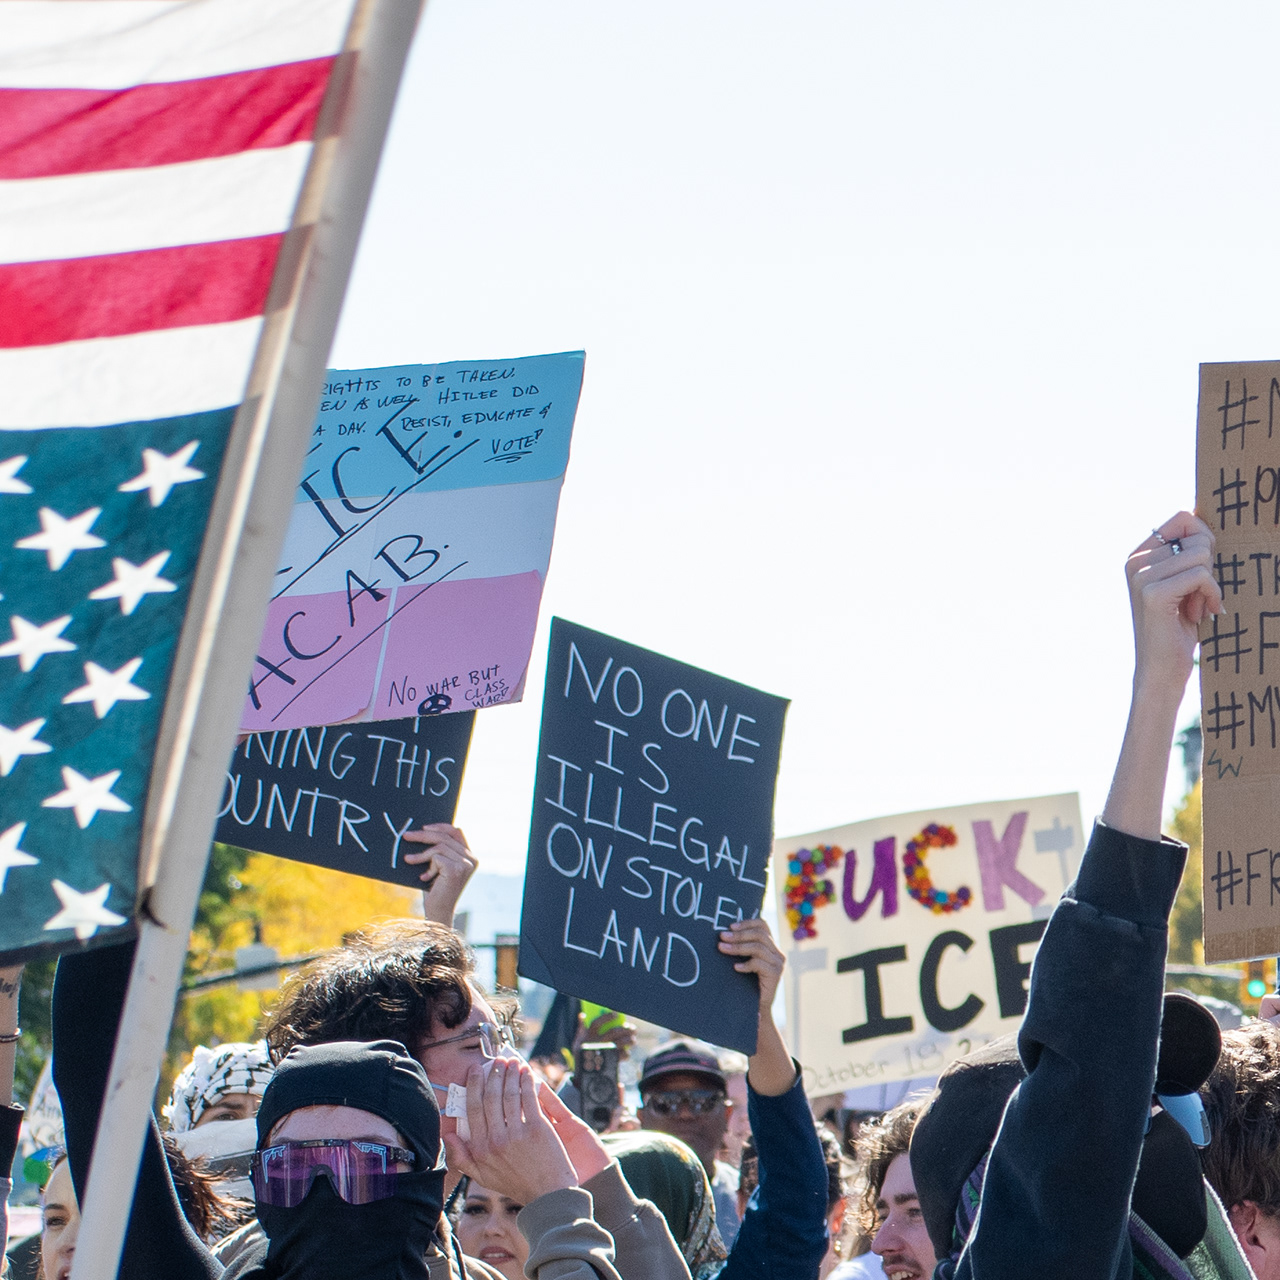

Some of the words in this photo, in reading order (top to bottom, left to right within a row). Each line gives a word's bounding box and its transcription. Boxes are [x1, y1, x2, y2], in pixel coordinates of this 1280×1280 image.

[396, 376, 412, 388] TO
[422, 374, 445, 388] BE
[438, 387, 499, 405] HITLER
[512, 385, 539, 398] DID
[337, 421, 367, 437] DAY.
[461, 407, 534, 425] EDUCATE
[426, 675, 461, 697] WAR
[468, 664, 501, 686] BUT
[464, 678, 506, 701] CLASS
[564, 640, 644, 717] NO
[660, 688, 761, 764] ONE
[243, 726, 357, 780] NING
[366, 733, 456, 797] THIS
[594, 719, 669, 794] IS
[214, 770, 414, 869] OUNTRY
[544, 754, 767, 888] ILLEGAL
[546, 822, 614, 889] ON
[783, 810, 1047, 942] FUCK
[563, 886, 700, 988] LAND
[836, 918, 1050, 1046] ICE
